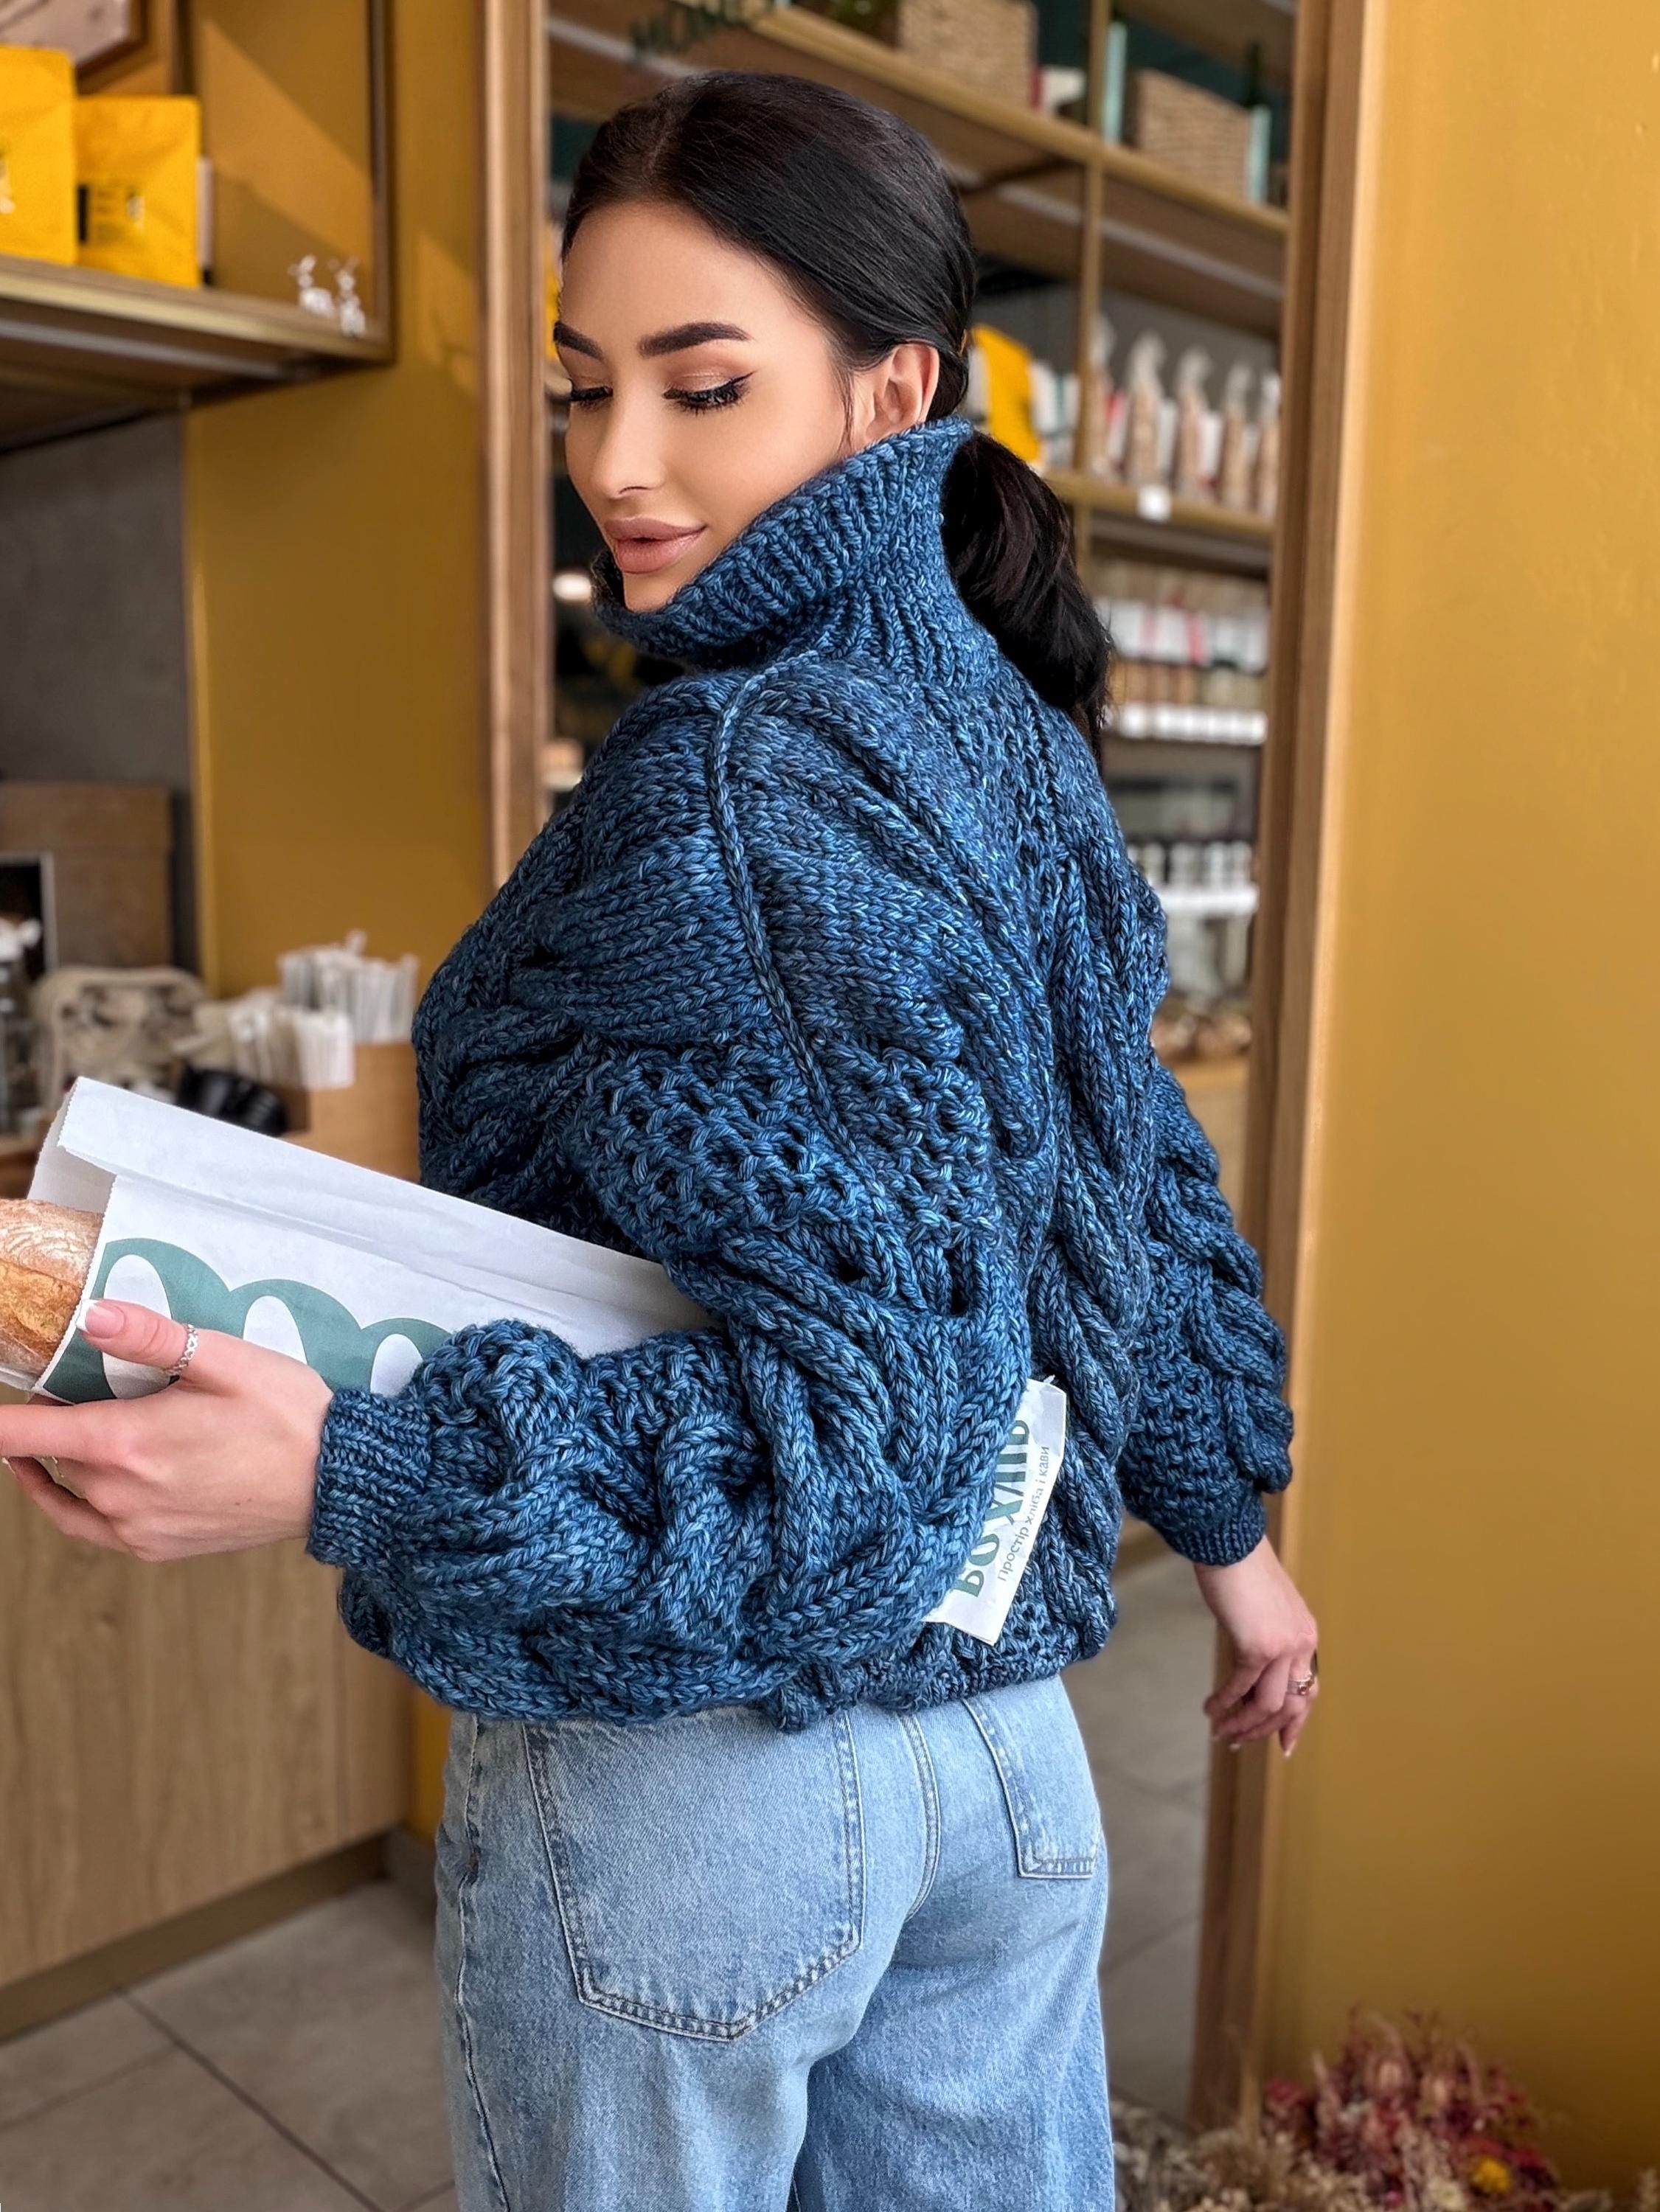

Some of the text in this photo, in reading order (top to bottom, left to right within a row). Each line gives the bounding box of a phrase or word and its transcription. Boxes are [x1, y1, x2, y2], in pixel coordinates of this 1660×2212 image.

[998, 1526, 1029, 1582] Простір
[1025, 1488, 1044, 1525] хліба
[1038, 1446, 1050, 1477] кави
